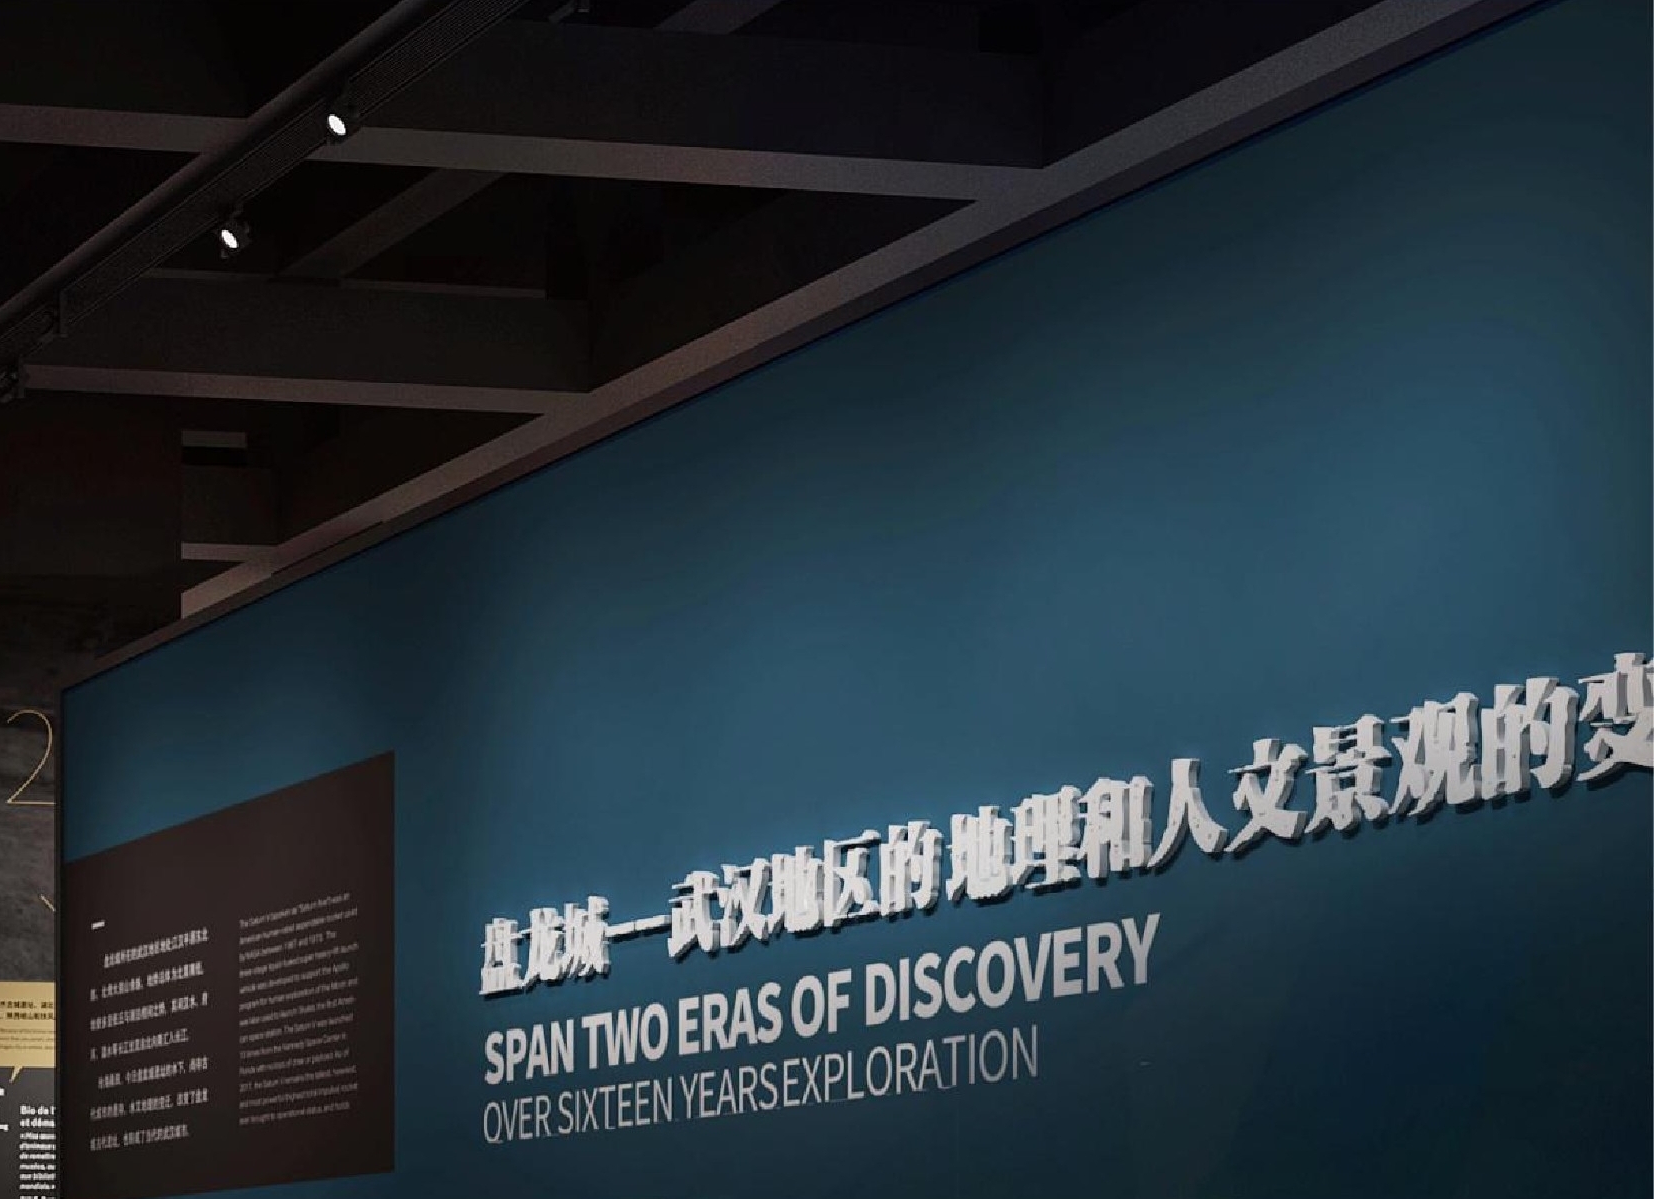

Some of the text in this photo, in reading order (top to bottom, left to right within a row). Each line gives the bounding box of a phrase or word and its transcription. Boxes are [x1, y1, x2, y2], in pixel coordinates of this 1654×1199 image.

[484, 913, 1161, 1086] SPAN TWO ERAS OF DISCOVERY
[483, 1094, 551, 1144] OVER
[557, 1077, 673, 1134] SIXTEEN
